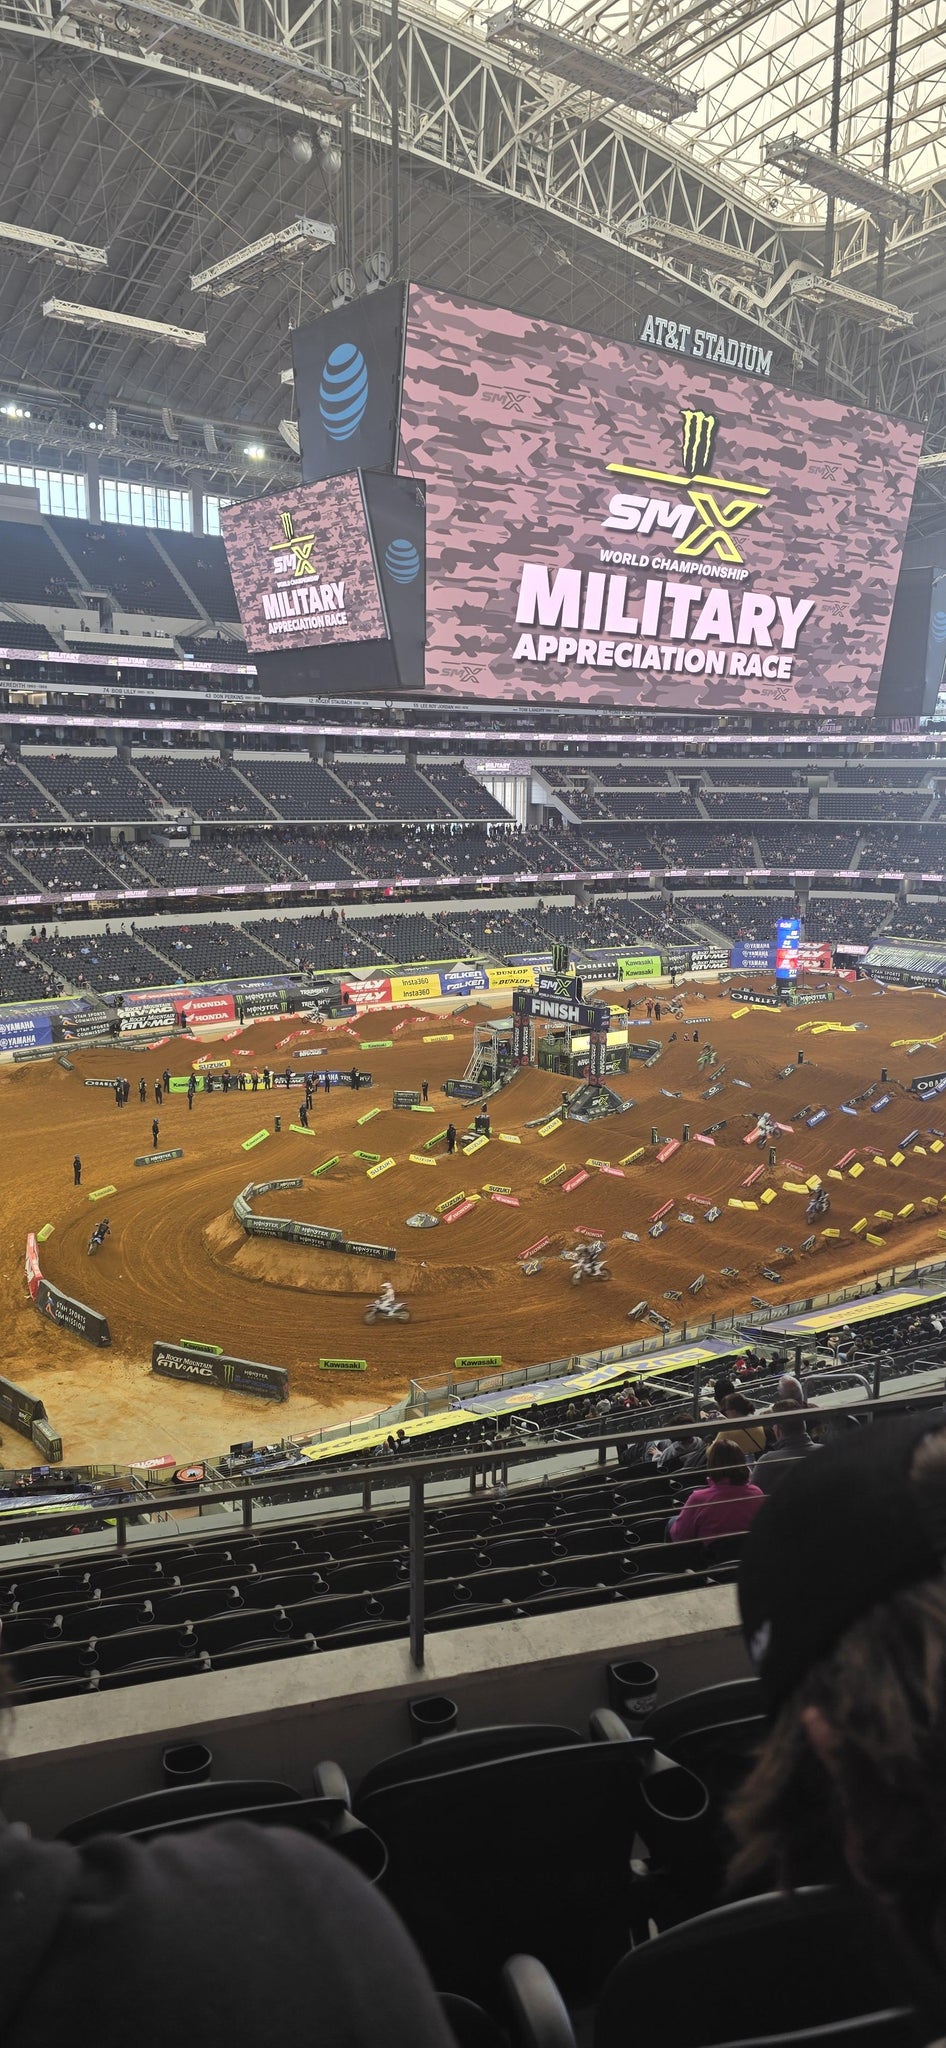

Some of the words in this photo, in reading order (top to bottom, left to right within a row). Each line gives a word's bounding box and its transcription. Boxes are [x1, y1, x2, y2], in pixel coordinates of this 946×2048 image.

[640, 315, 691, 352] AT&T
[693, 329, 773, 376] STADIUM
[601, 491, 759, 563] SMX
[273, 543, 317, 576] SMX
[600, 549, 649, 568] WORLD
[651, 556, 749, 581] CHAMPIONSHIP
[262, 581, 345, 620] MILITARY
[515, 563, 815, 649] MILITARY
[268, 615, 325, 634] APPRECIATION
[325, 612, 348, 627] RACE
[512, 633, 725, 674] APPRECIATION
[729, 652, 793, 679] RACE
[445, 970, 482, 980] FALKEN
[911, 975, 939, 984] MONSTER
[402, 977, 429, 986] Insta360
[446, 980, 484, 990] FALKEN
[403, 988, 430, 997] Insta360
[540, 978, 572, 997] SMX
[245, 992, 278, 1000] MONSTER
[742, 994, 777, 1005] OAKLEY
[800, 993, 827, 1002] MONSTER
[193, 1000, 228, 1009] HONDA
[247, 1004, 279, 1012] MONSTER
[532, 1000, 580, 1022] FINISH
[75, 1015, 107, 1023] COMMISSION
[195, 1013, 229, 1021] HONDA
[6, 1021, 35, 1031] YAMAHA
[77, 1028, 110, 1037] COMMISSION
[7, 1035, 36, 1045] YAMAHA
[199, 1061, 227, 1070] SUZUKI
[541, 1120, 560, 1134] SUZUKI
[465, 1136, 487, 1153] SUZUKI
[150, 1153, 171, 1161] MONSTER
[370, 1160, 393, 1175] SUZUKI
[489, 1186, 510, 1194] SUZUKI
[441, 1193, 465, 1210] SUZUKI
[453, 1203, 473, 1218] HONDA
[302, 1227, 328, 1236] MONSTER
[585, 1230, 603, 1238] HONDA
[353, 1245, 381, 1255] MONSTER
[529, 1239, 549, 1256] HONDA
[56, 1301, 68, 1313] UTAH
[69, 1306, 86, 1324] SPORTS
[55, 1309, 86, 1332] COMMISSION
[166, 1354, 183, 1364] ROCKY
[183, 1358, 213, 1369] MOUNTAIN
[324, 1360, 361, 1370] Kawasaki
[461, 1357, 498, 1367] Kawasaki
[244, 1370, 269, 1379] MONSTER
